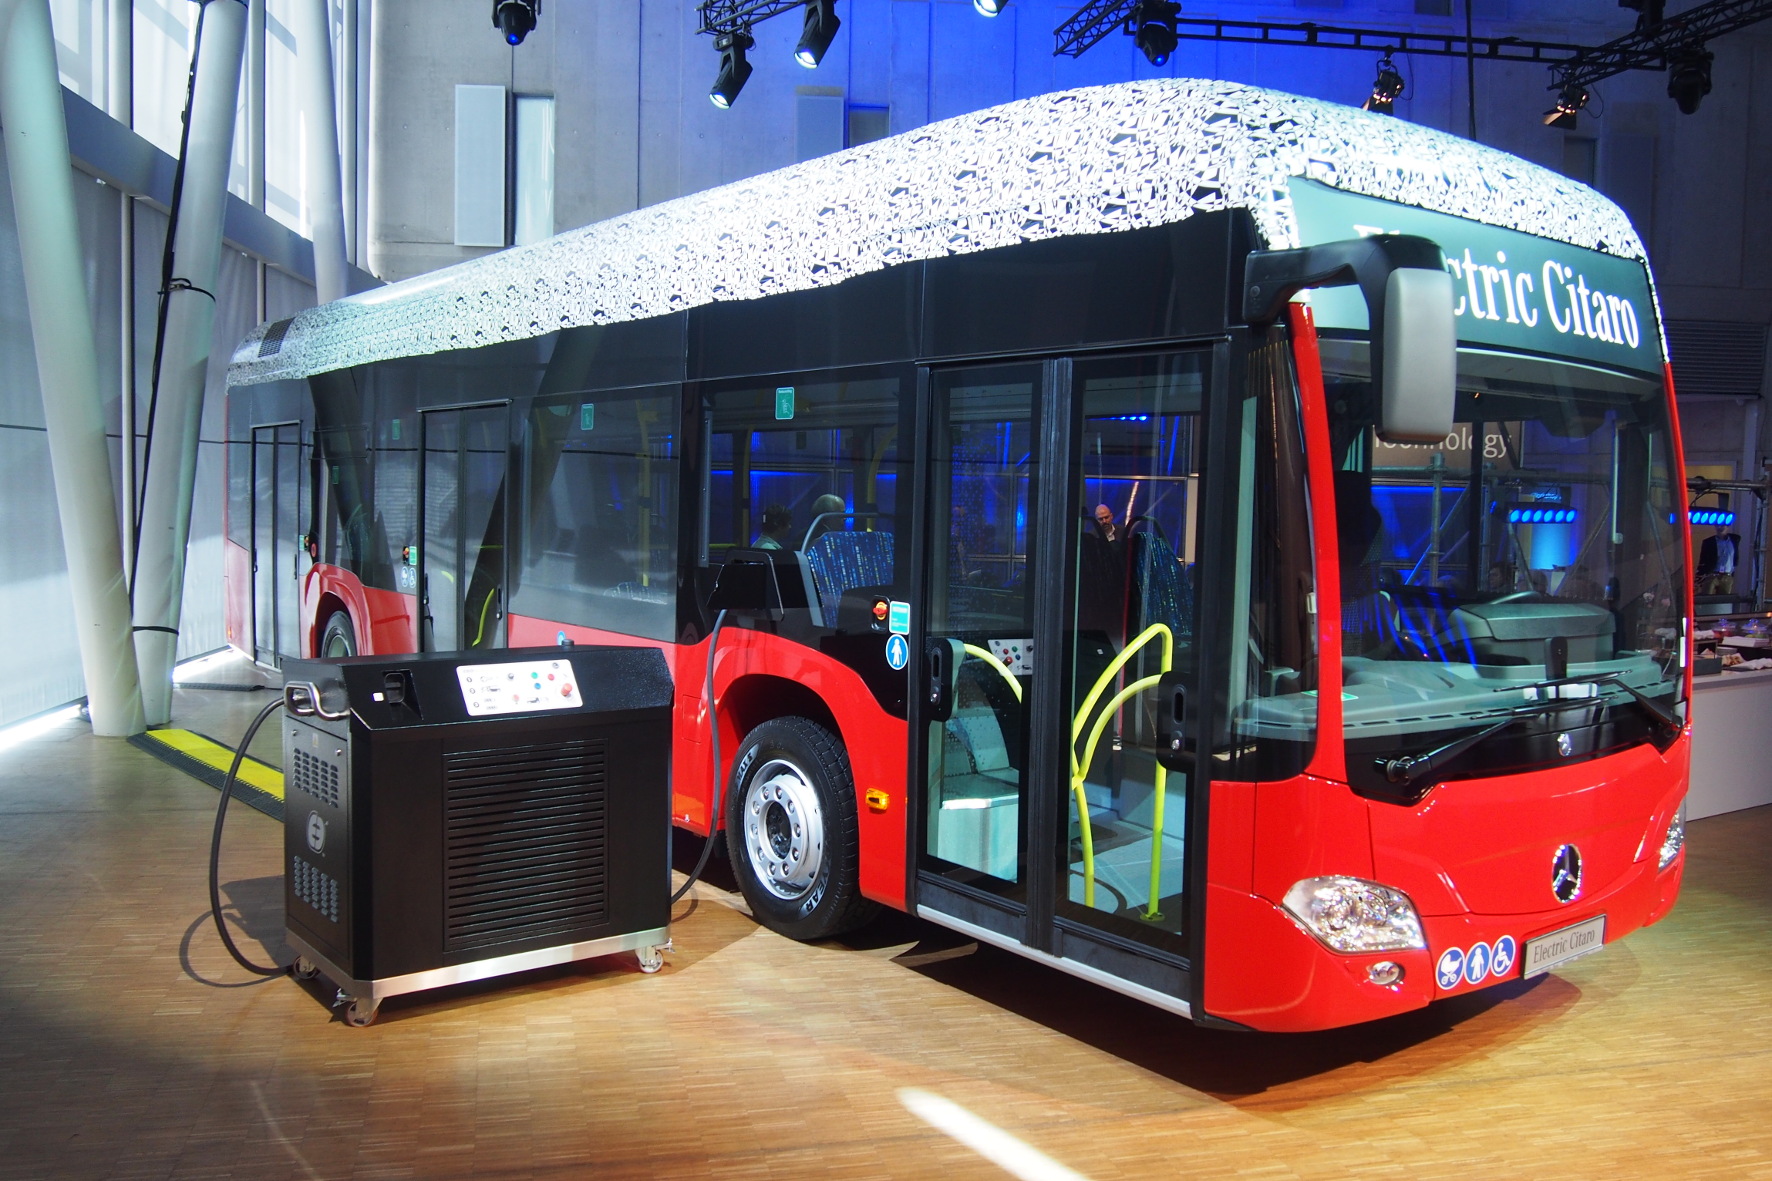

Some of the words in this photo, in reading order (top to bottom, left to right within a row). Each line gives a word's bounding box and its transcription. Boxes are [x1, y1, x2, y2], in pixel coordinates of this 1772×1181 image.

[1542, 259, 1640, 349] Citaro
[1533, 937, 1568, 964] Electric
[1569, 929, 1596, 950] Citaro
